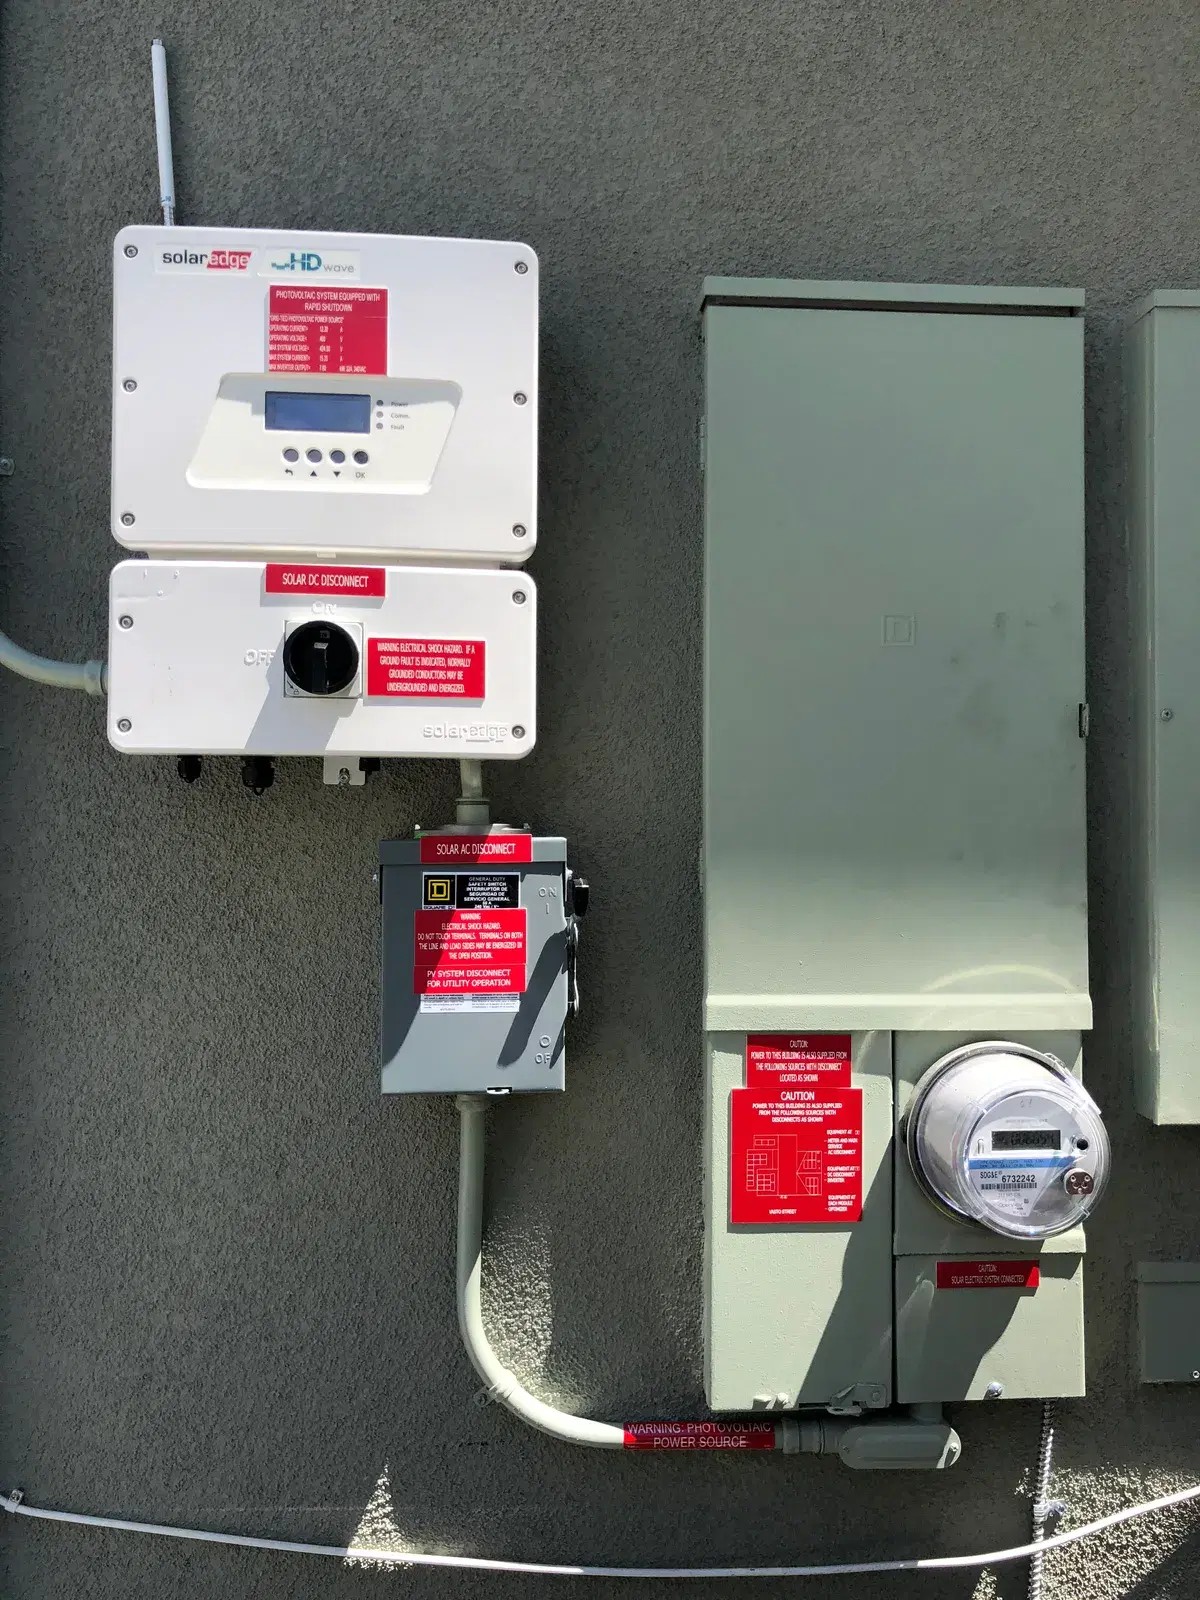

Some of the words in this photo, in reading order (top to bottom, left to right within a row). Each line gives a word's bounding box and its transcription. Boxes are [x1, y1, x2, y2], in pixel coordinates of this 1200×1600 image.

[162, 250, 251, 270] solaredge
[290, 252, 322, 271] HD
[323, 263, 354, 273] wave
[276, 291, 315, 299] PHOTOVOLTAIC
[317, 292, 338, 300] SYSTEM
[339, 293, 366, 301] EQUIPPED
[305, 303, 321, 311] RAPID
[322, 303, 352, 312] SHUTDOWN
[283, 573, 306, 586] SOLAR
[308, 574, 319, 586] DC
[321, 575, 369, 587] DISCONNECT
[311, 601, 337, 615] ON
[377, 643, 399, 651] WARNING
[400, 643, 426, 652] ELECTRICAL
[428, 644, 444, 653] SHOCK
[466, 645, 471, 654] IF
[471, 645, 475, 654] A
[244, 649, 276, 666] OFF
[380, 655, 400, 665] GROUND
[401, 656, 415, 666] FAULT
[415, 657, 420, 666] IS
[448, 658, 471, 667] NORMALLY
[389, 670, 414, 679] GROUNDED
[416, 670, 446, 680] CONDUCTORS
[447, 671, 457, 680] MAY
[457, 671, 463, 680] BE
[387, 683, 427, 692] UNDERGROUNDED
[428, 683, 438, 693] AND
[422, 721, 508, 742] solaredge
[437, 844, 458, 855] SOLAR
[461, 844, 470, 855] AC
[472, 843, 516, 855] DISCONNECT
[538, 887, 557, 898] ON
[443, 979, 470, 987] UTILITY
[780, 1074, 797, 1082] LOCATED
[798, 1074, 803, 1082] AS
[803, 1074, 818, 1082] SHOWN
[781, 1092, 815, 1100] CAUTION
[1002, 1175, 1035, 1183] 6732242
[951, 1276, 964, 1284] SOLAR
[965, 1276, 984, 1284] ELECTRIC
[984, 1275, 1000, 1283] SYSTEM
[1000, 1275, 1024, 1283] CONNECTED
[627, 1423, 684, 1434] WARNING:
[687, 1423, 771, 1433] PHOTOVOLTAIC
[654, 1436, 695, 1448] POWER
[700, 1436, 746, 1447] SOURCE
